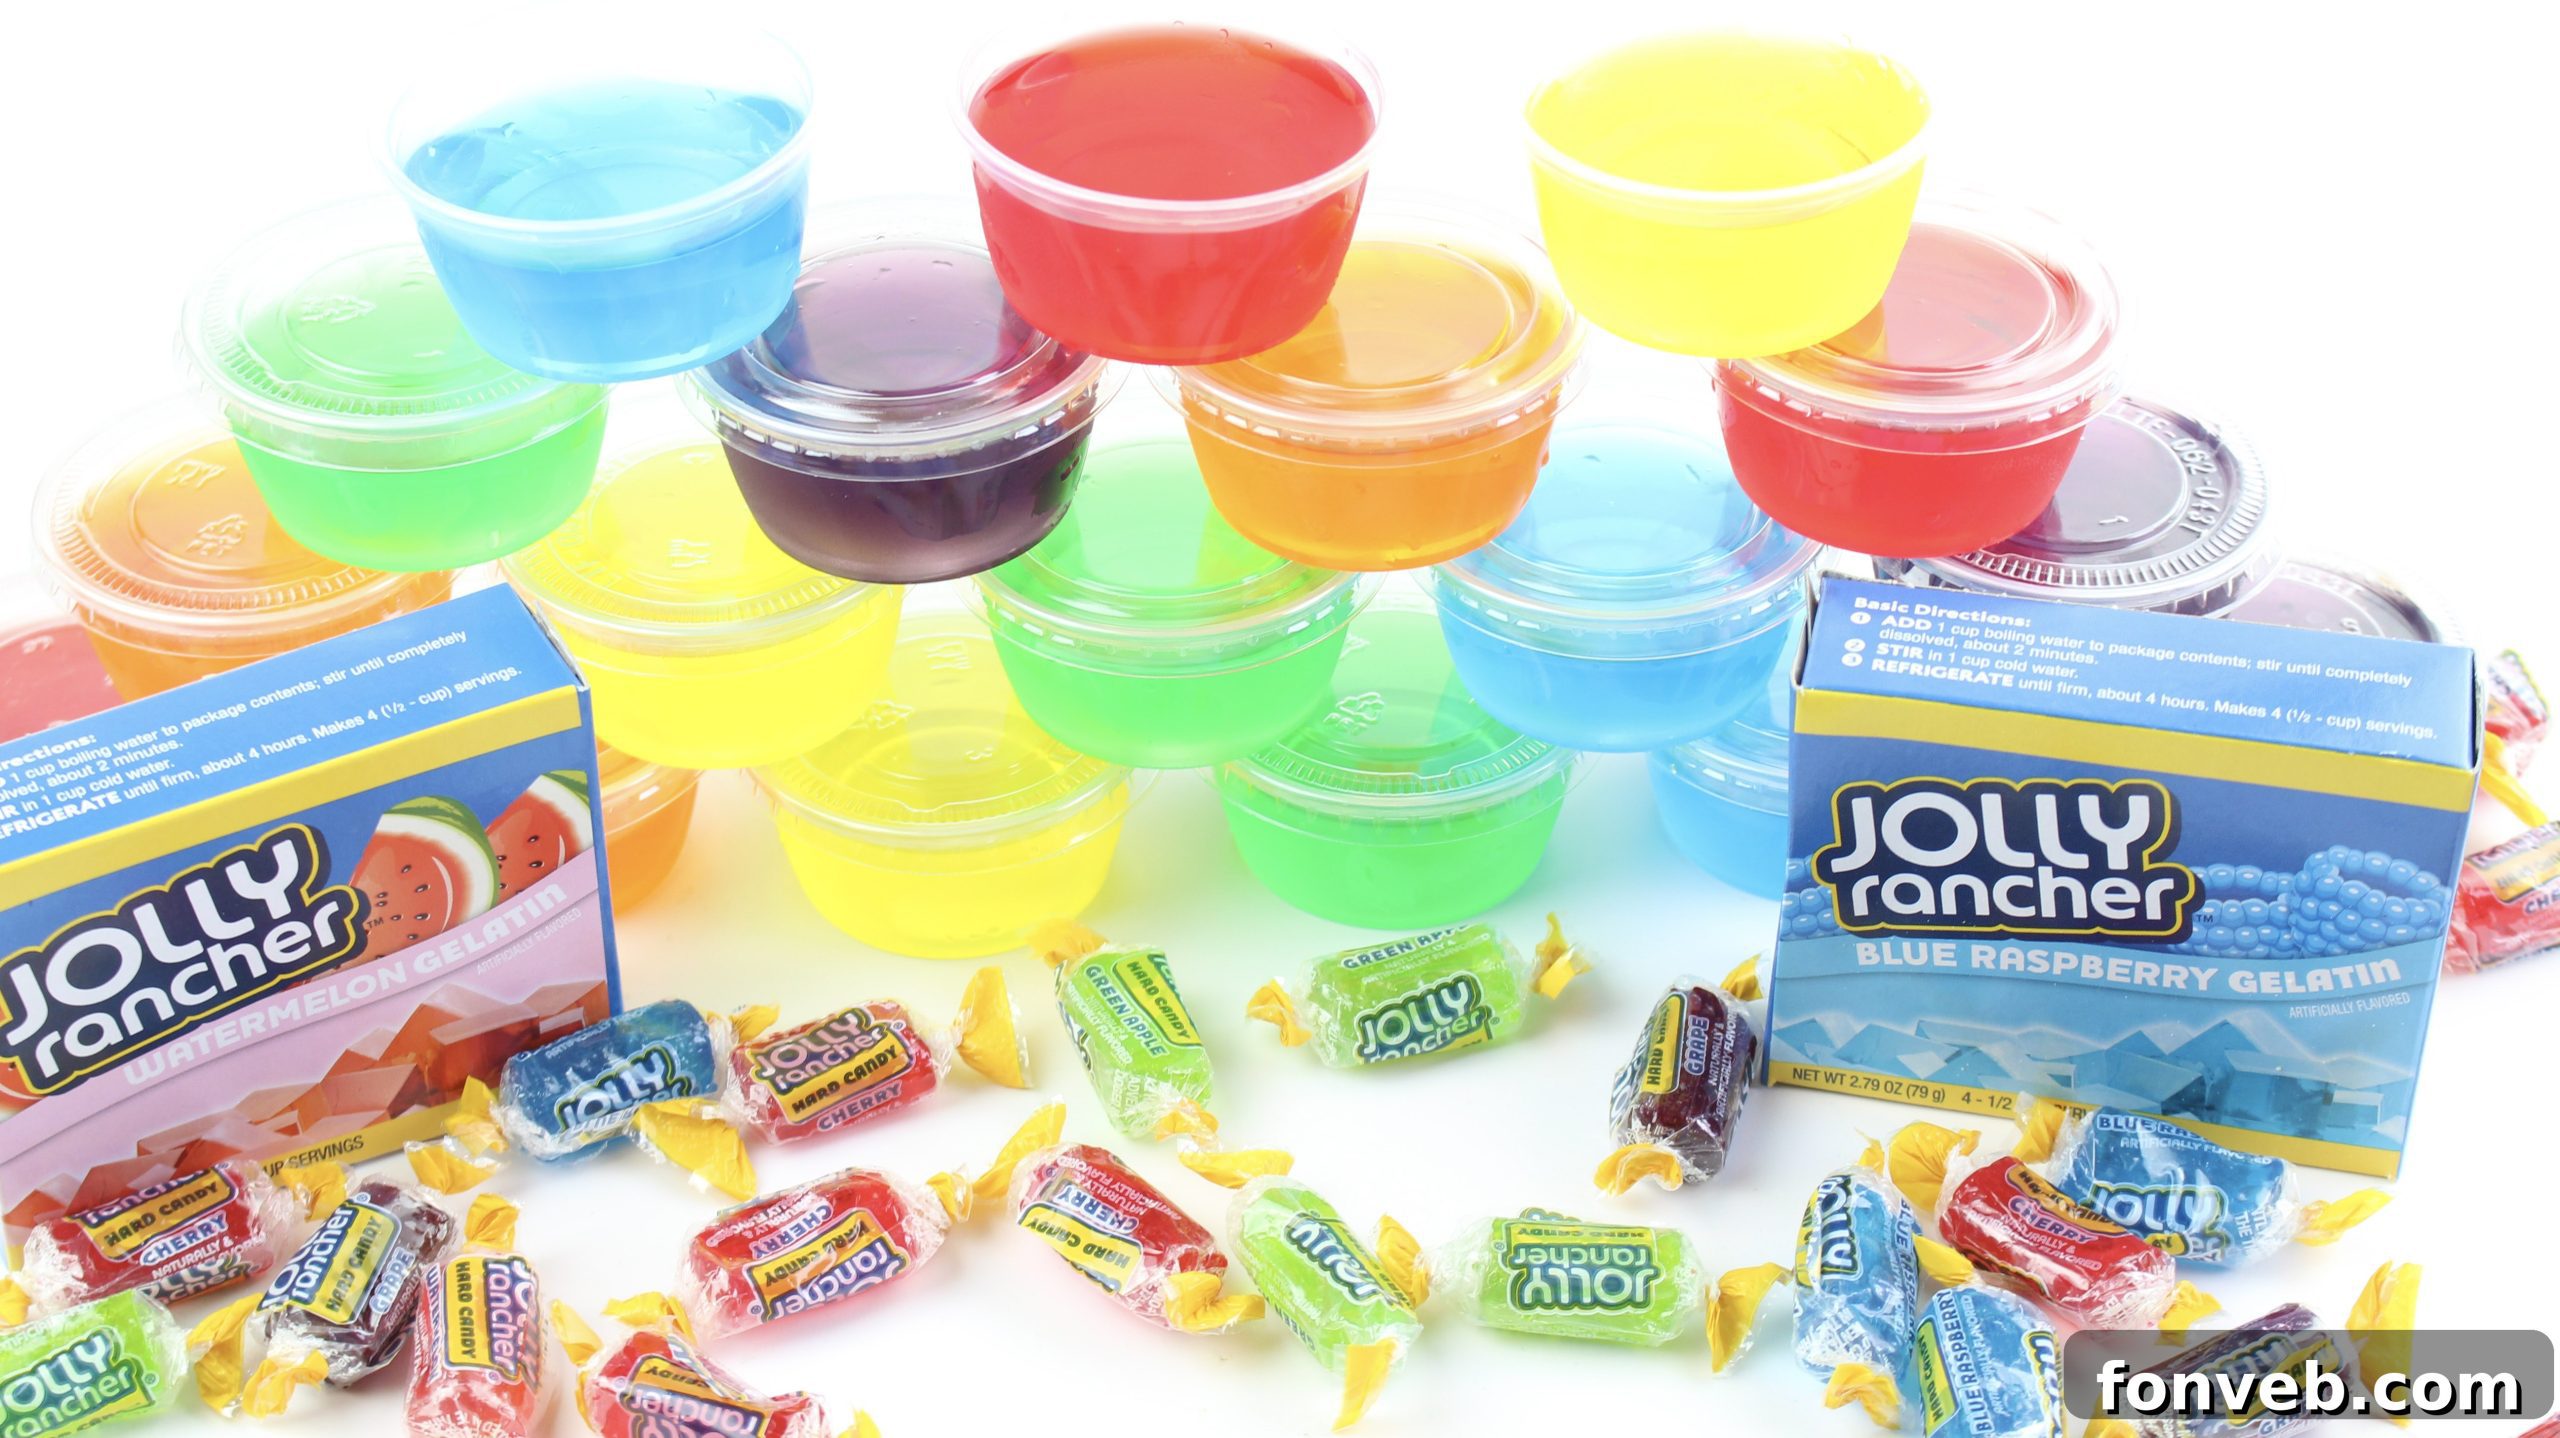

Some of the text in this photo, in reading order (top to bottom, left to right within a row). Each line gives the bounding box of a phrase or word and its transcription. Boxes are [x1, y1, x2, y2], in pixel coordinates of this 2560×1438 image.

[1854, 597, 2032, 628] Basic Directions:
[1876, 643, 2079, 680] STIR in 1 cup cold water.
[1879, 629, 2098, 665] dissolved, about 2 minutes.
[1881, 615, 2412, 688] ADD 1 cup boiling water to package contents; stir until completely
[9, 772, 20, 783] 1
[25, 763, 55, 779] cup
[57, 745, 112, 769] boiling
[113, 730, 158, 751] water
[161, 724, 179, 737] to
[181, 702, 247, 732] package
[250, 679, 321, 709] contents;
[322, 669, 347, 686] stir
[350, 657, 384, 676] until
[386, 630, 467, 664] completely
[1871, 659, 2014, 687] REFRIGERATE
[2018, 678, 2052, 692] until
[2056, 681, 2092, 698] firm,
[2097, 687, 2141, 703] about
[2145, 693, 2156, 704] 4
[2160, 693, 2210, 712] hours.
[2213, 699, 2267, 719] Makes
[2270, 707, 2282, 719] 4
[2326, 714, 2362, 732] cup)
[2366, 719, 2438, 740] servings.
[123, 778, 160, 800] until
[161, 768, 200, 788] firm,
[201, 752, 247, 775] about
[249, 748, 260, 759] 4
[261, 733, 312, 756] hours.
[311, 714, 365, 740] Makes
[367, 709, 378, 722] 4
[418, 686, 452, 705] cup)
[453, 665, 522, 695] servings.
[21, 759, 175, 812] in 1 cup cold water.
[47, 766, 96, 787] about
[98, 760, 110, 772] 2
[112, 738, 184, 767] minutes.
[1831, 791, 2150, 873] JOLLY
[1851, 866, 2214, 924] rancher TM
[6, 839, 299, 1046] JOLLY
[477, 907, 583, 976] ARTIFICIALLY FLAVORED
[1343, 941, 1414, 969] GREEN
[1855, 941, 2401, 994] BLUE RASPBERRY GELATIN
[31, 900, 384, 1077] rancher TM
[122, 882, 568, 1086] WATERMELON GELATIN
[1086, 967, 1130, 1015] GREEN
[1124, 1016, 1168, 1056] APPLE
[1127, 961, 1190, 1039] HARD CANDY
[2289, 992, 2411, 1019] ARTIFICIALLY FLAVORED
[757, 1012, 862, 1078] JOLLY
[1363, 981, 1471, 1054] JOLLY
[1370, 1010, 1484, 1063] rancher
[1687, 1017, 1708, 1075] GRAPE
[775, 1027, 883, 1090] rancher
[791, 1045, 899, 1114] HARD CANDY
[1646, 1046, 1664, 1085] HARD
[1703, 1028, 1728, 1085] NATURALLY
[564, 1053, 666, 1130] JOLLY
[818, 1083, 901, 1131] CHERRY
[1792, 1067, 1820, 1082] NET
[1824, 1072, 1847, 1087] WT
[1850, 1075, 1880, 1092] 2.79
[1884, 1080, 1903, 1096] OZ
[1906, 1082, 1928, 1099] (79
[1932, 1086, 1946, 1104] g)
[1962, 1091, 1972, 1105] 4
[1988, 1095, 2012, 1111] 1/2
[2100, 1117, 2153, 1133] BLUE
[263, 1135, 364, 1180] UP SERVINGS
[103, 1181, 220, 1247] HARD CANDY
[1058, 1188, 1138, 1231] CHERRY
[1082, 1177, 1147, 1217] NATURALLY
[1112, 1178, 1182, 1221] ARTIFICIALLY
[2011, 1198, 2093, 1243] CHERRY
[2096, 1188, 2214, 1233] JOLLY
[142, 1212, 229, 1265] CHERRY
[152, 1236, 234, 1280] NATURALLY &
[292, 1207, 354, 1300] rancher
[754, 1205, 832, 1256] CHERRY
[1026, 1218, 1130, 1269] HARD CANDY
[1514, 1247, 1647, 1269] rancher
[2001, 1214, 2067, 1251] NATURALLY
[139, 1255, 228, 1298] OLLY
[326, 1216, 382, 1311] HARD CANDY
[372, 1252, 413, 1312] GRAPE
[776, 1241, 888, 1320] rancher
[1291, 1222, 1377, 1297] JOLLY
[1523, 1267, 1655, 1304] JOLLY
[456, 1261, 476, 1359] HARD CANDY
[488, 1263, 516, 1376] rancher
[1908, 1335, 1944, 1422] HARD CANDY
[1936, 1289, 1993, 1432] BLUE RASPBERRY
[4, 1366, 131, 1438] rancher
[632, 1388, 758, 1434] rancher
